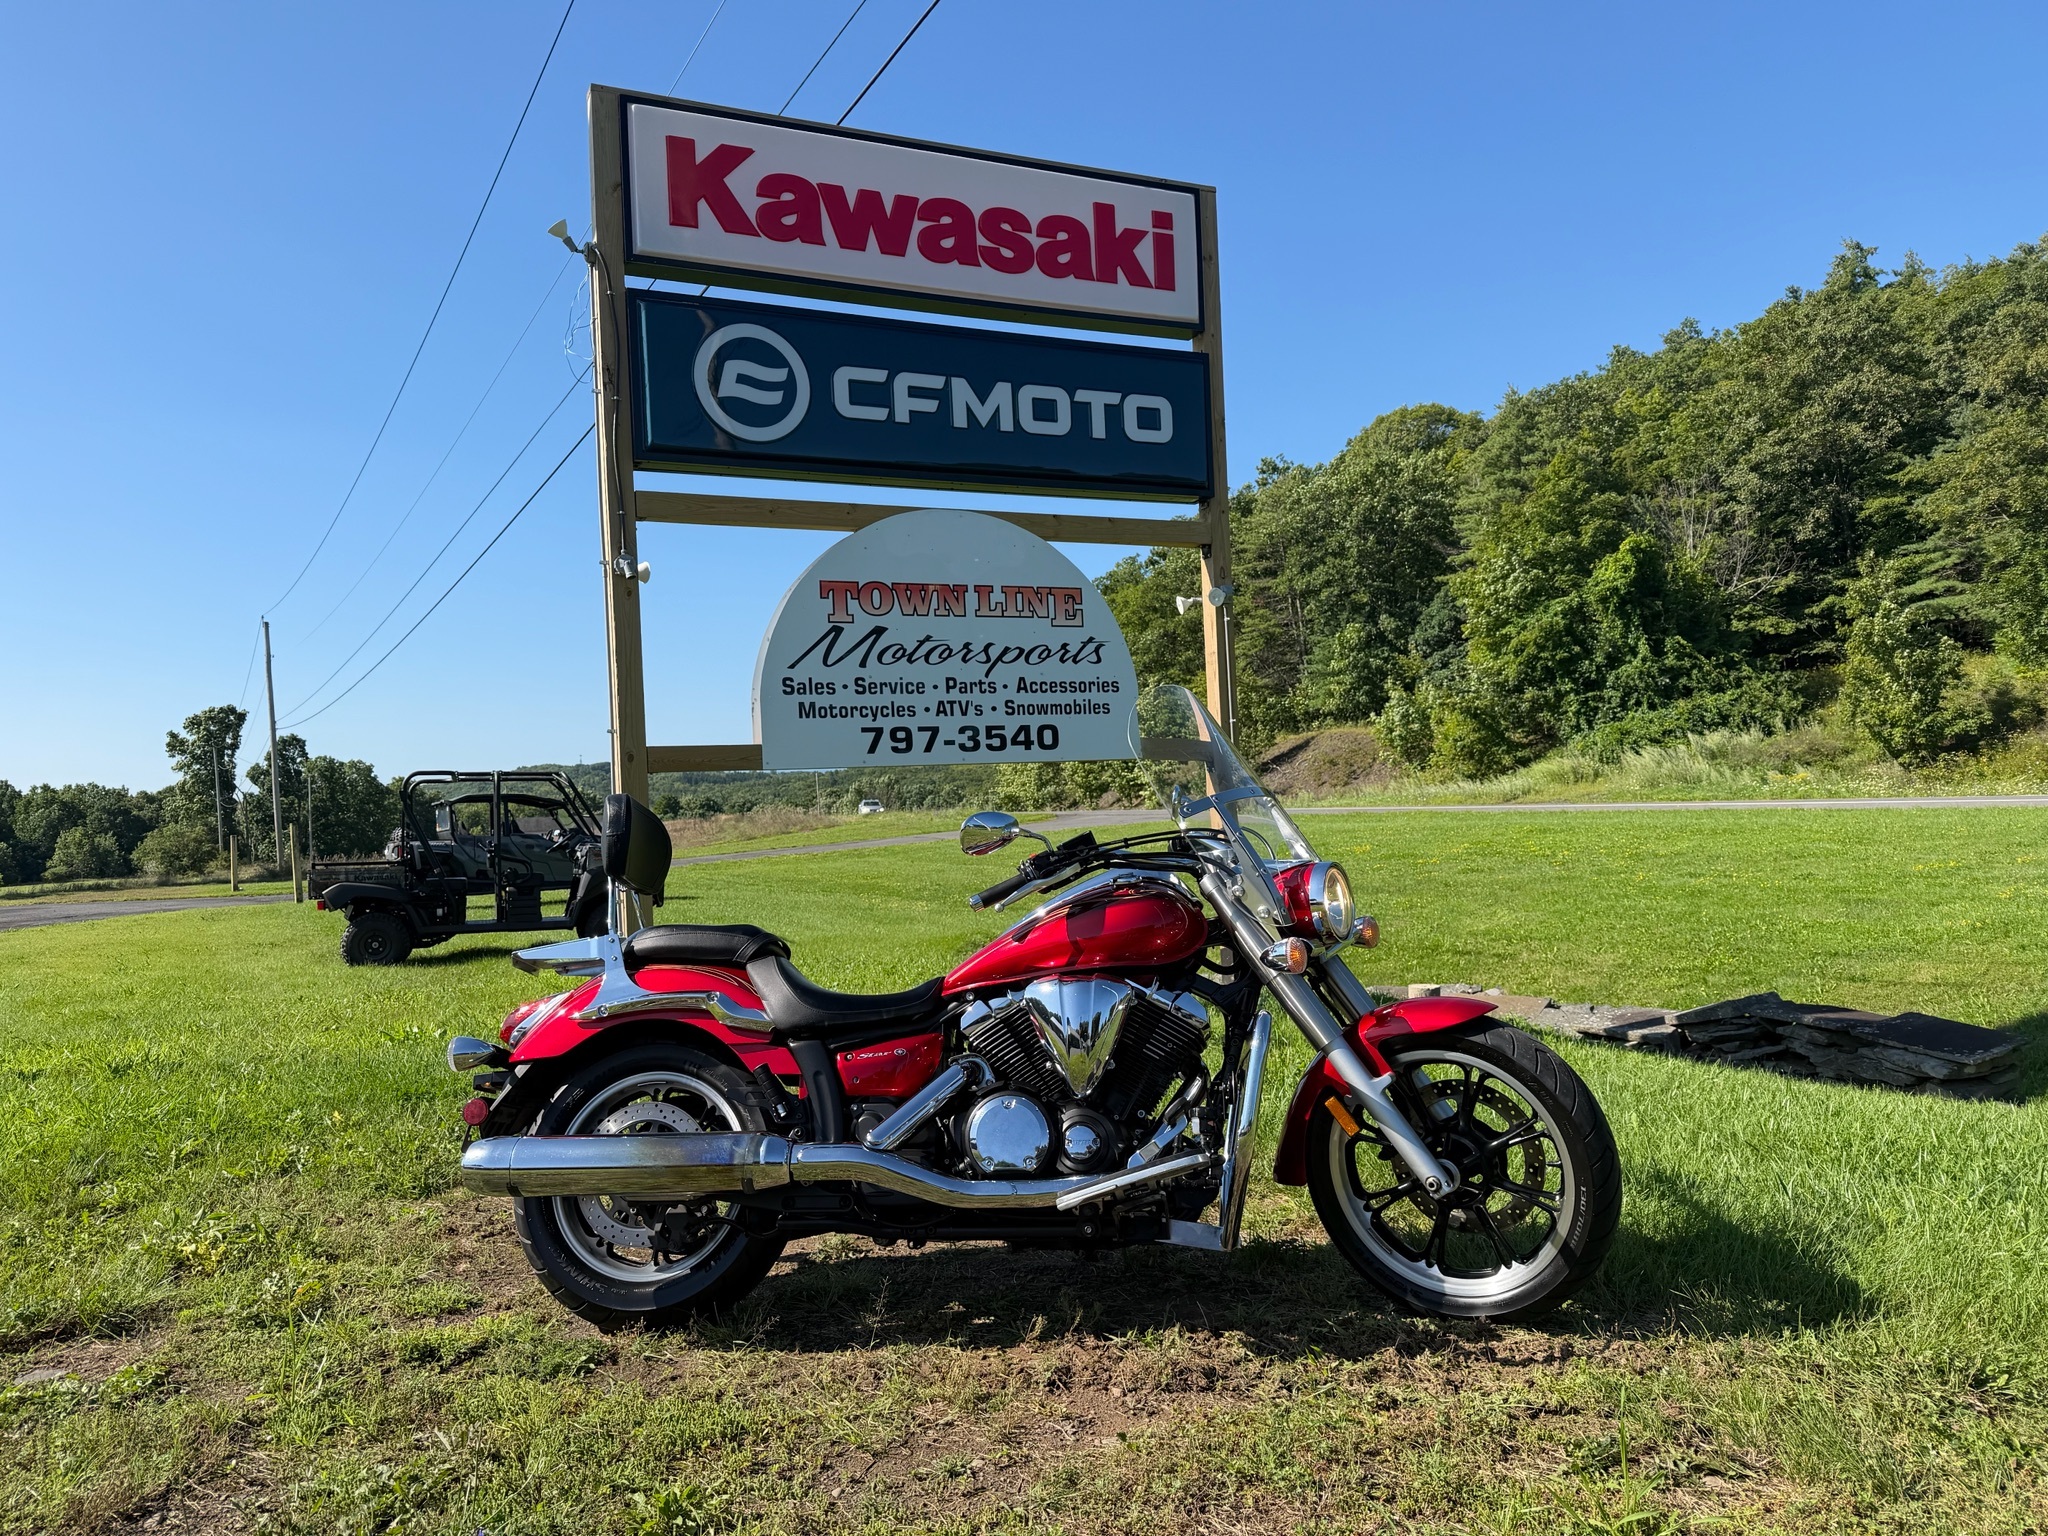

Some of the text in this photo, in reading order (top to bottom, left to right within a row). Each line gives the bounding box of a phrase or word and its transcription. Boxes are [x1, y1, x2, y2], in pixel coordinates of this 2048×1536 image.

[665, 135, 1176, 291] Kawasaki
[832, 366, 1173, 444] CFMOTO
[819, 580, 1084, 627] TOWN LINE
[787, 625, 1111, 678] Motorsports
[782, 676, 1120, 695] Sales Service Parts Accessories
[798, 699, 1111, 721] Motorcycles ATV's Snowmobiles
[860, 724, 1060, 754] 797-3540
